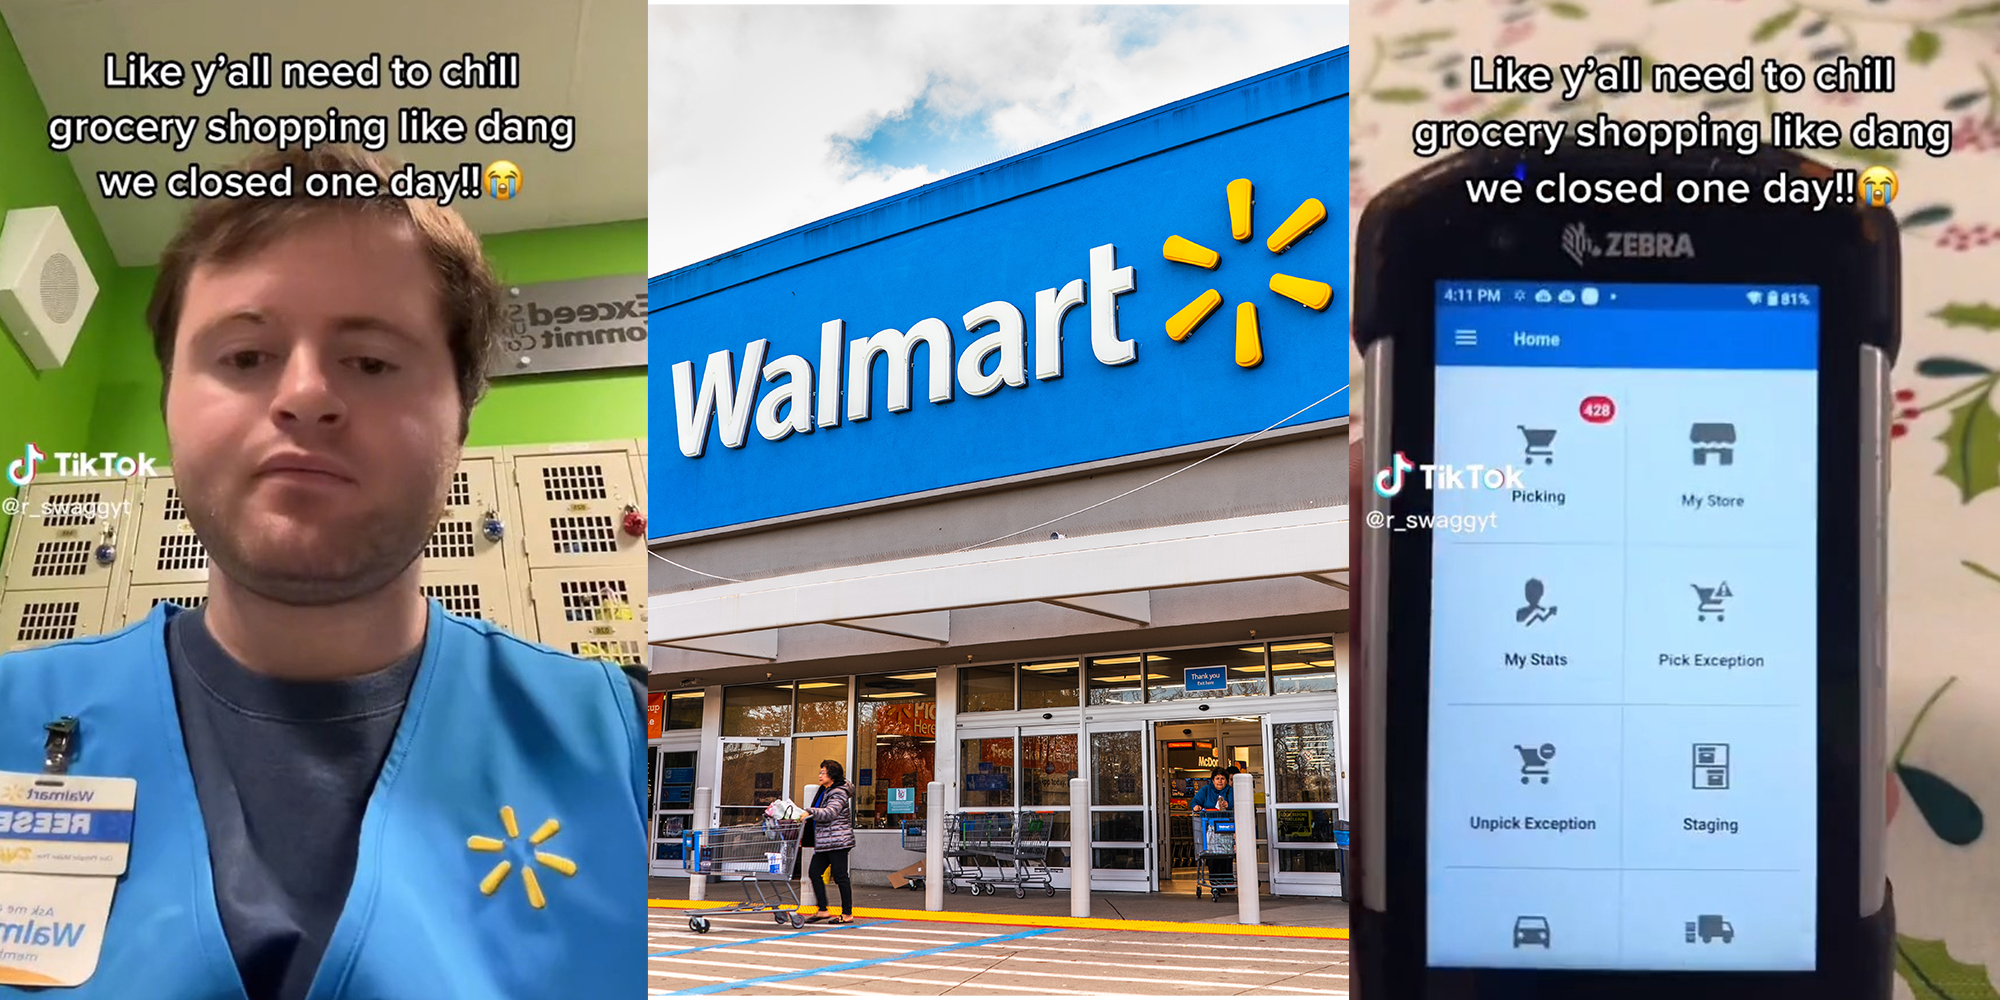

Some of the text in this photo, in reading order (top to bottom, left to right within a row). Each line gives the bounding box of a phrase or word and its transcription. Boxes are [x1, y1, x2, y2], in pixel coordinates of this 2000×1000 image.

[1604, 232, 1696, 258] ZEBRA
[1443, 288, 1501, 302] 4:11 PM
[1780, 292, 1811, 306] 81%
[1513, 331, 1561, 347] Home
[671, 242, 1139, 459] Walmart
[1582, 403, 1611, 417] 428
[1511, 489, 1567, 506] Picking
[1681, 494, 1745, 510] My Store
[1504, 652, 1569, 669] My Stats
[1658, 653, 1765, 670] Pick Exception
[1191, 672, 1221, 681] Thank you
[913, 718, 937, 735] Here
[1469, 816, 1597, 834] Unpick Exception
[1683, 817, 1739, 834] Staging
